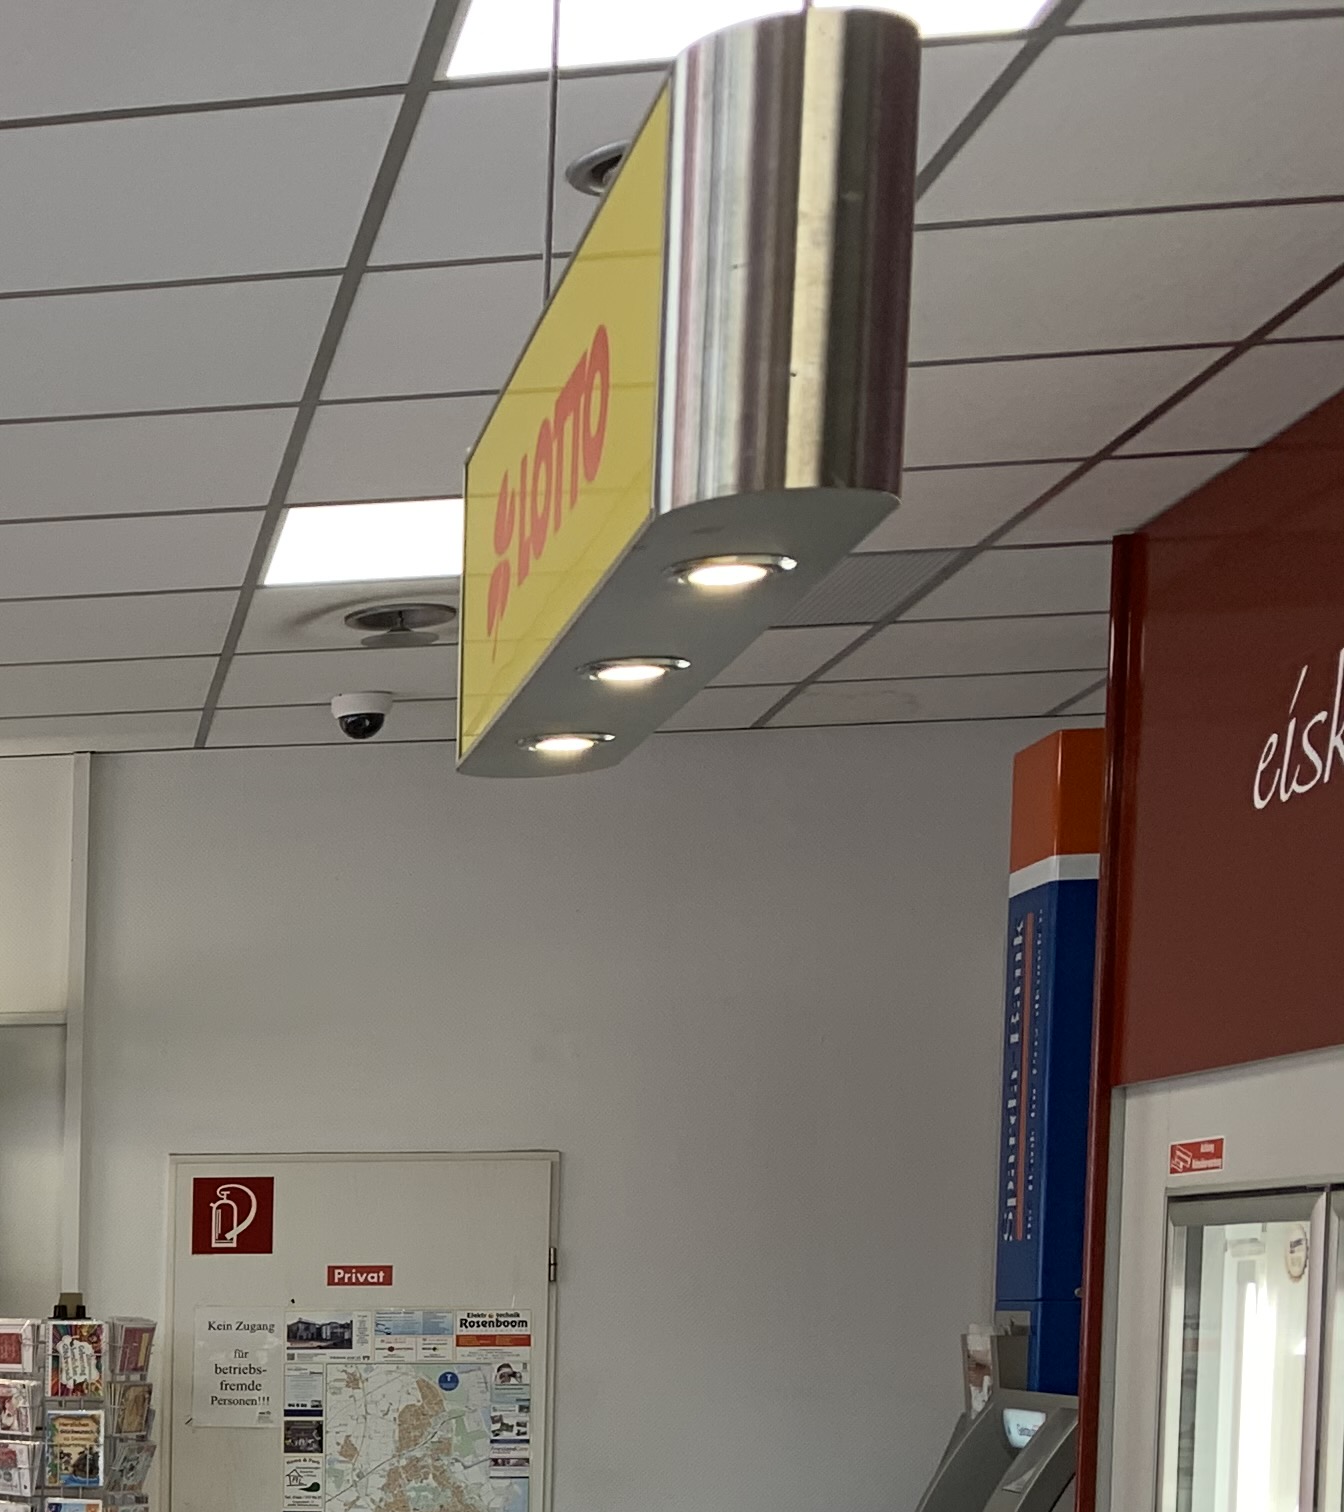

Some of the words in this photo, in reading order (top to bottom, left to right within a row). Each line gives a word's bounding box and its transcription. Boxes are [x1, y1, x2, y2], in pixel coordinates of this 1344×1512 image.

[517, 325, 610, 587] LOTTO
[334, 1269, 385, 1283] Privat
[207, 1321, 233, 1332] Kein
[236, 1321, 275, 1334] Zugang
[459, 1318, 528, 1329] Rosenboom
[233, 1349, 249, 1360] für
[214, 1364, 267, 1376] betriebs-
[219, 1379, 262, 1392] fremde
[210, 1396, 270, 1408] Personen!!!
